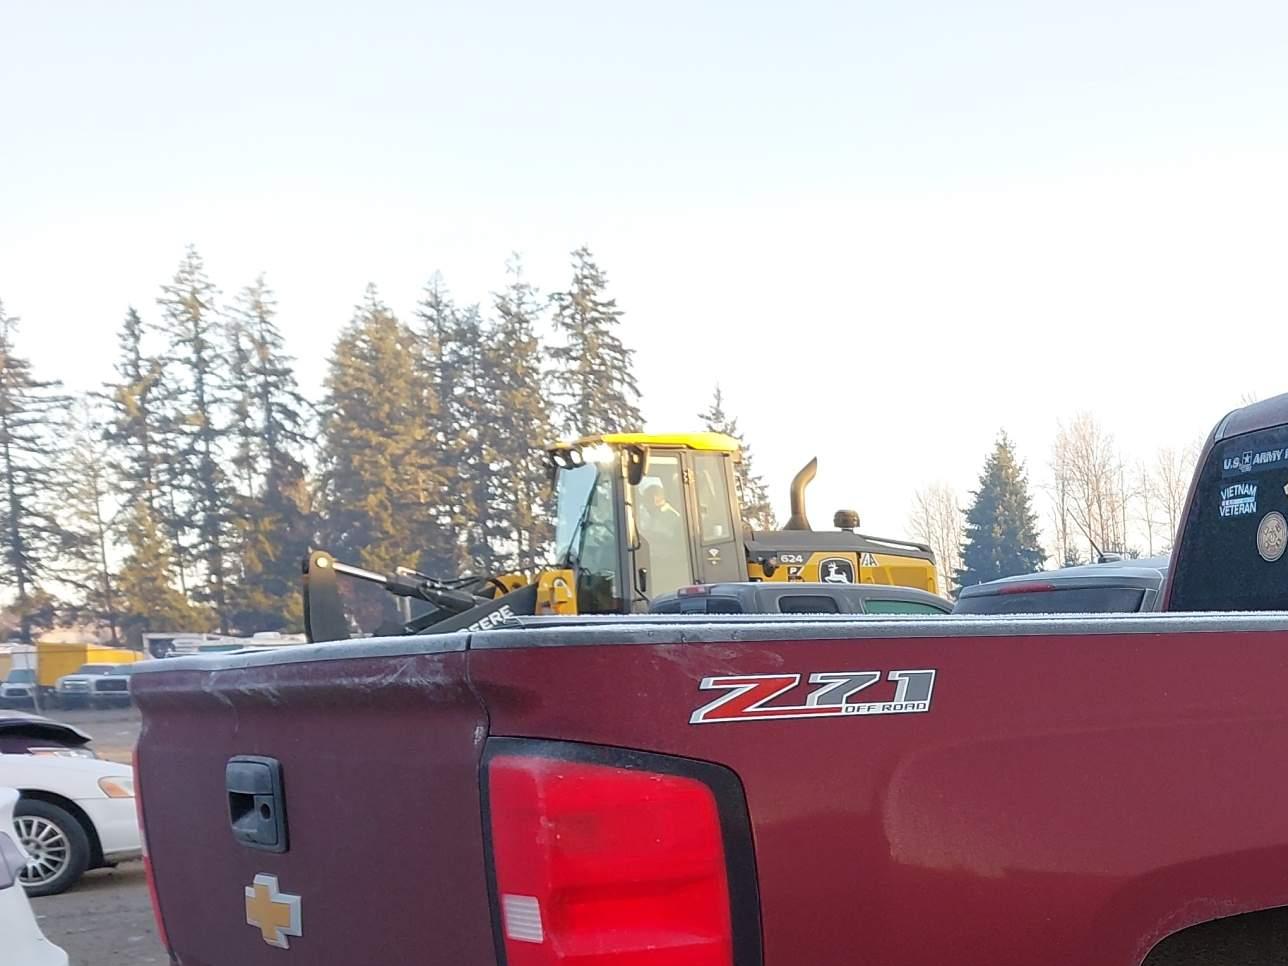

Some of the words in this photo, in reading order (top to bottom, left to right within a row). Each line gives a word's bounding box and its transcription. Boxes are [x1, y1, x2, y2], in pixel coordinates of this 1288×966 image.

[1252, 449, 1284, 465] ARMY
[1221, 483, 1257, 500] VIETNAM
[1219, 501, 1257, 517] VETERAN
[780, 554, 804, 564] 624
[457, 604, 515, 632] EERE
[689, 669, 936, 724] Z71
[844, 704, 878, 714] OFF
[881, 702, 928, 713] ROAD
